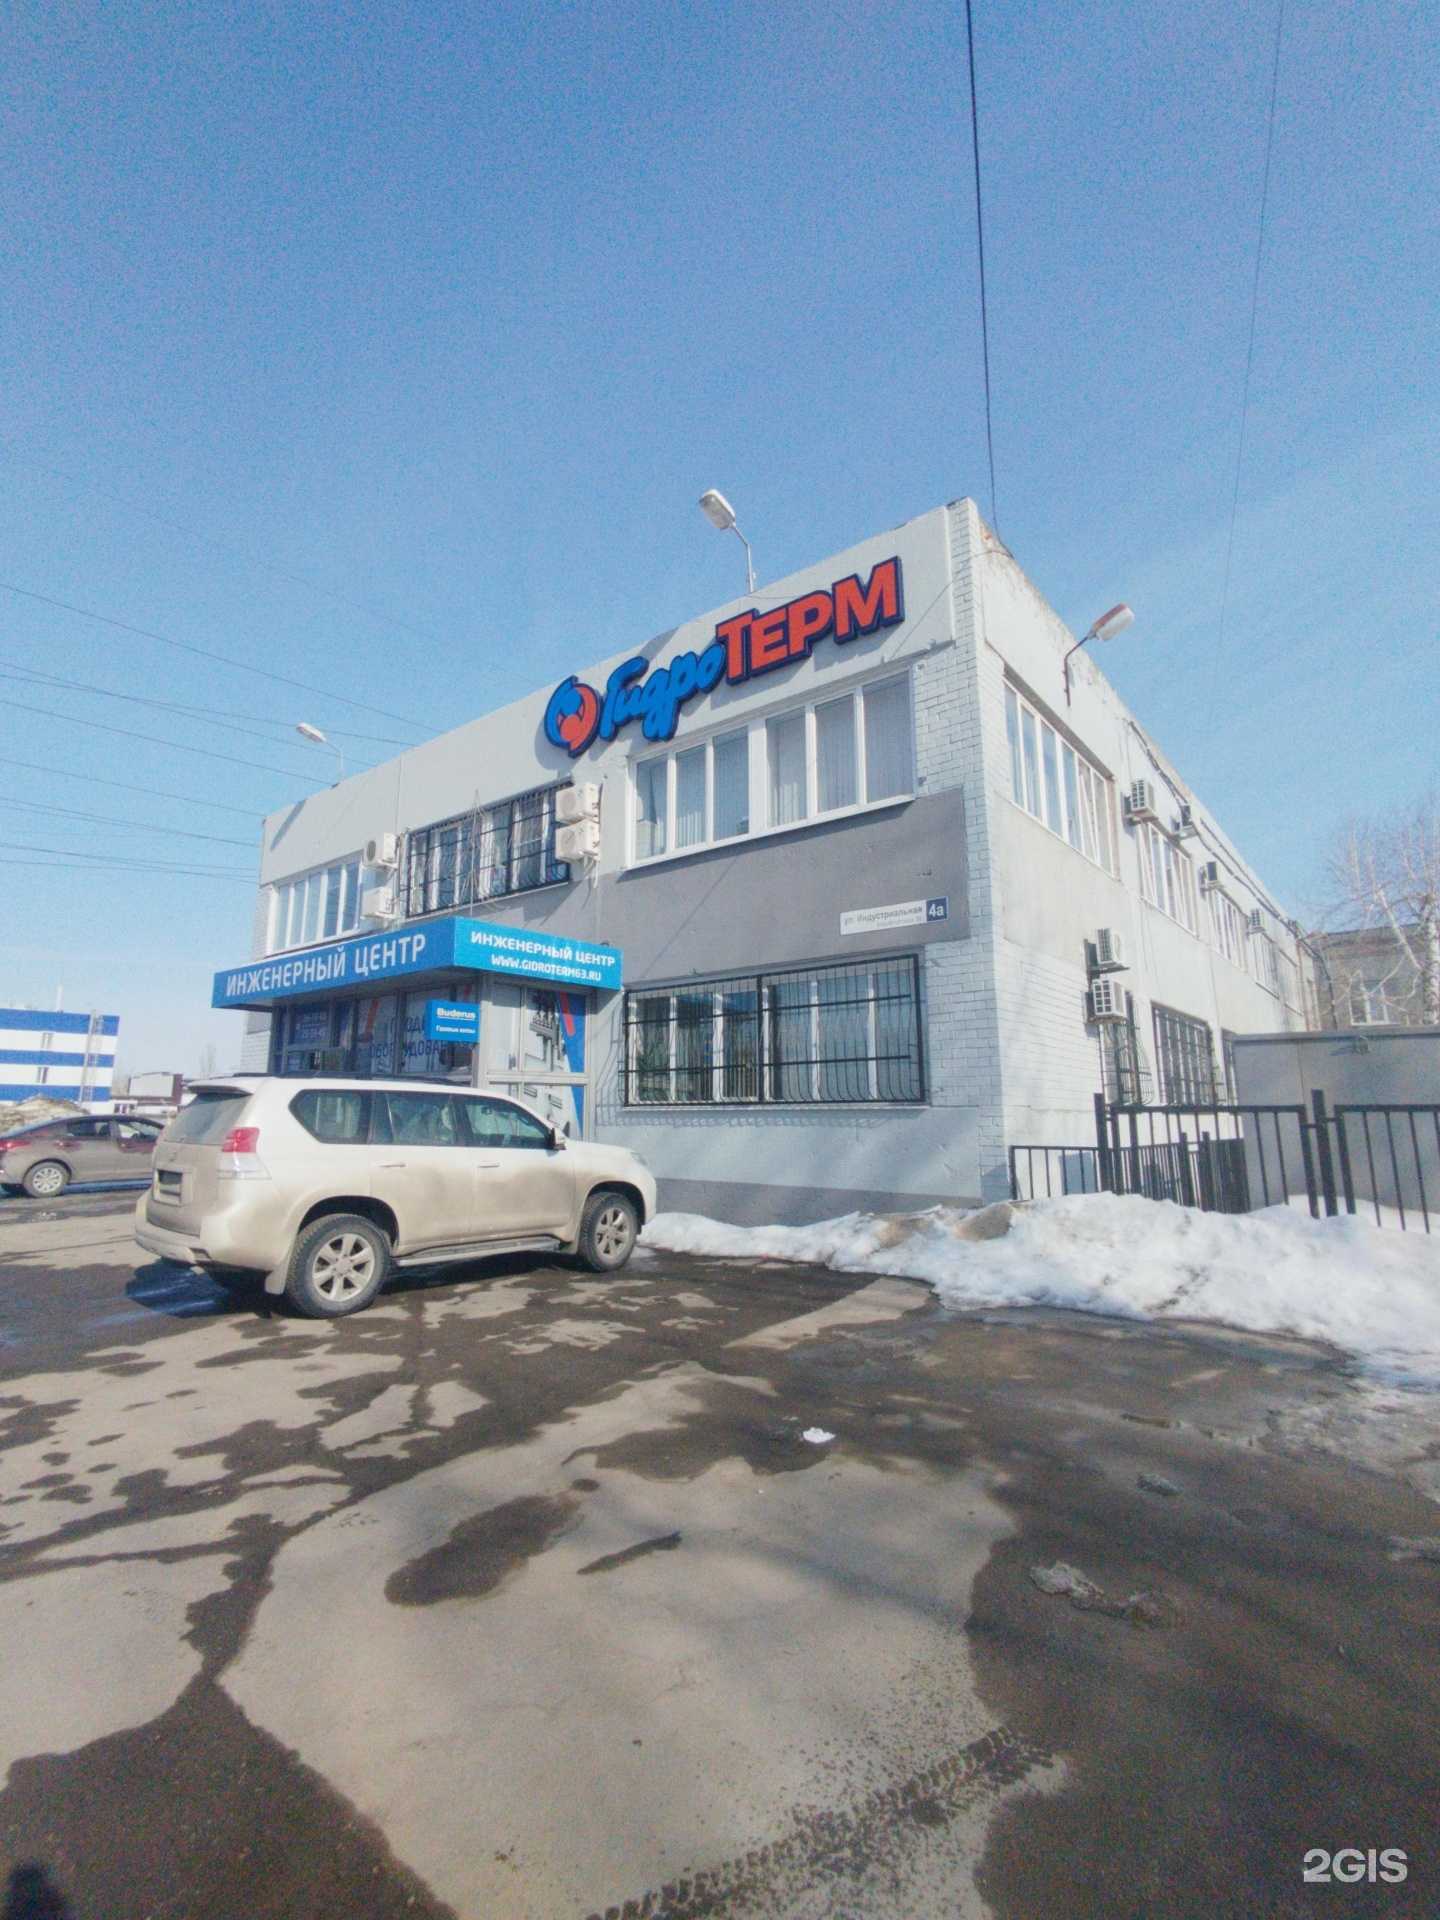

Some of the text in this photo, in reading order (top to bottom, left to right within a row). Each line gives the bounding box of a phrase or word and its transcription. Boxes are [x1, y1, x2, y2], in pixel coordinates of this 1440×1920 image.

[226, 933, 426, 997] ИНЖЕНЕРНЫЙ ЦЕНТР
[471, 930, 616, 967] ИНЖЕНЕРНЫЙ ЦЕНТР
[491, 954, 602, 982] WWW.GIDROTERM63.RU
